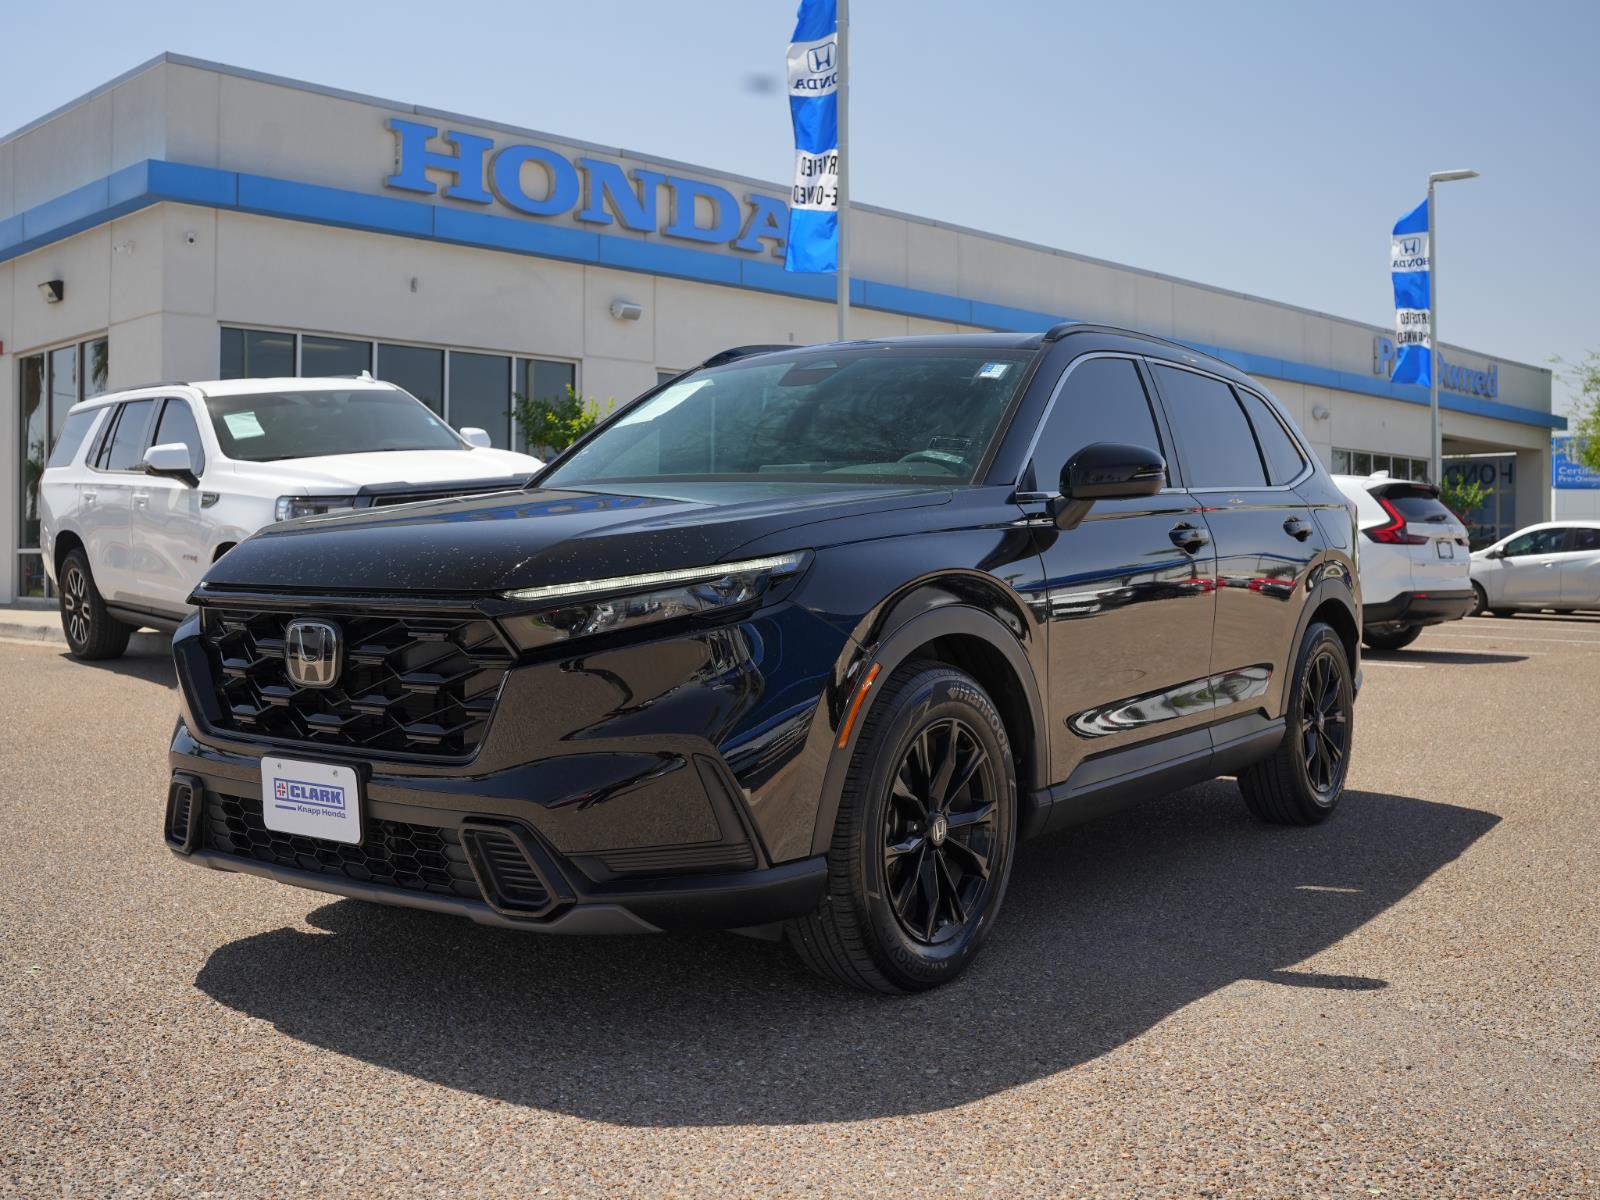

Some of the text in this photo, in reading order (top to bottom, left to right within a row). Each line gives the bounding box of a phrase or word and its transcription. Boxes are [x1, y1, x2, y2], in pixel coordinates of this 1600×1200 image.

[384, 117, 790, 259] HONDA
[290, 785, 342, 805] CLARK
[297, 804, 346, 819] Knapp Honda
